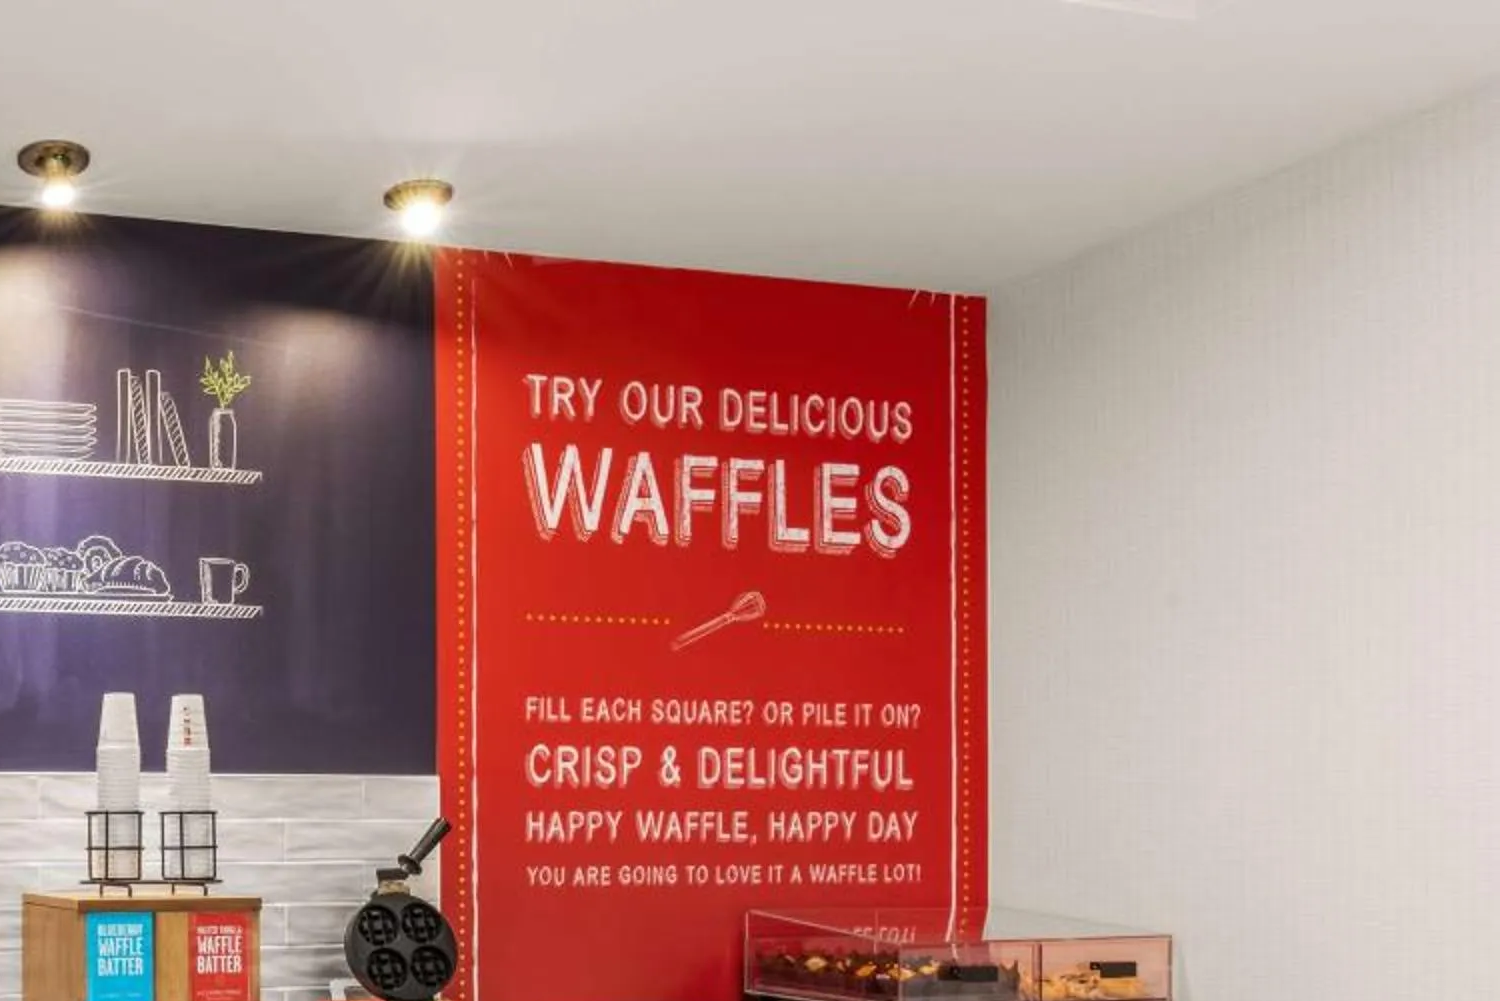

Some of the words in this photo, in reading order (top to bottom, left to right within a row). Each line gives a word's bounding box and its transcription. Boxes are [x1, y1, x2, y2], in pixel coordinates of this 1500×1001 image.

[523, 373, 603, 421] TRY
[620, 380, 704, 429] OUR
[718, 388, 913, 444] DELICIOUS
[521, 442, 912, 560] WAFFLES
[525, 696, 571, 723] FILL
[580, 697, 642, 724] EACH
[651, 699, 754, 726] SQUARE?
[762, 700, 794, 726] OR
[802, 702, 847, 728] PILE
[854, 702, 873, 728] IT
[881, 703, 922, 729] ON?
[525, 743, 642, 789] CRISP
[660, 745, 682, 788] &
[697, 745, 914, 791] DELIGHTFUL
[525, 810, 624, 844] HAPPY
[636, 810, 757, 847] WAFFLE,
[767, 811, 857, 843] HAPPY
[867, 810, 918, 842] DAY
[526, 865, 566, 887] YOU
[573, 865, 611, 887] ARE
[618, 865, 678, 886] GOING
[685, 865, 708, 885] TO
[715, 865, 762, 885] LOVE
[768, 864, 784, 884] IT
[791, 864, 803, 885] A
[810, 864, 877, 884] WAFFLE
[883, 863, 922, 883] LOT!
[98, 937, 144, 956] WAFFLE
[197, 936, 243, 955] WAFFLE
[98, 958, 143, 976] BATTER
[197, 955, 242, 974] BATTER
